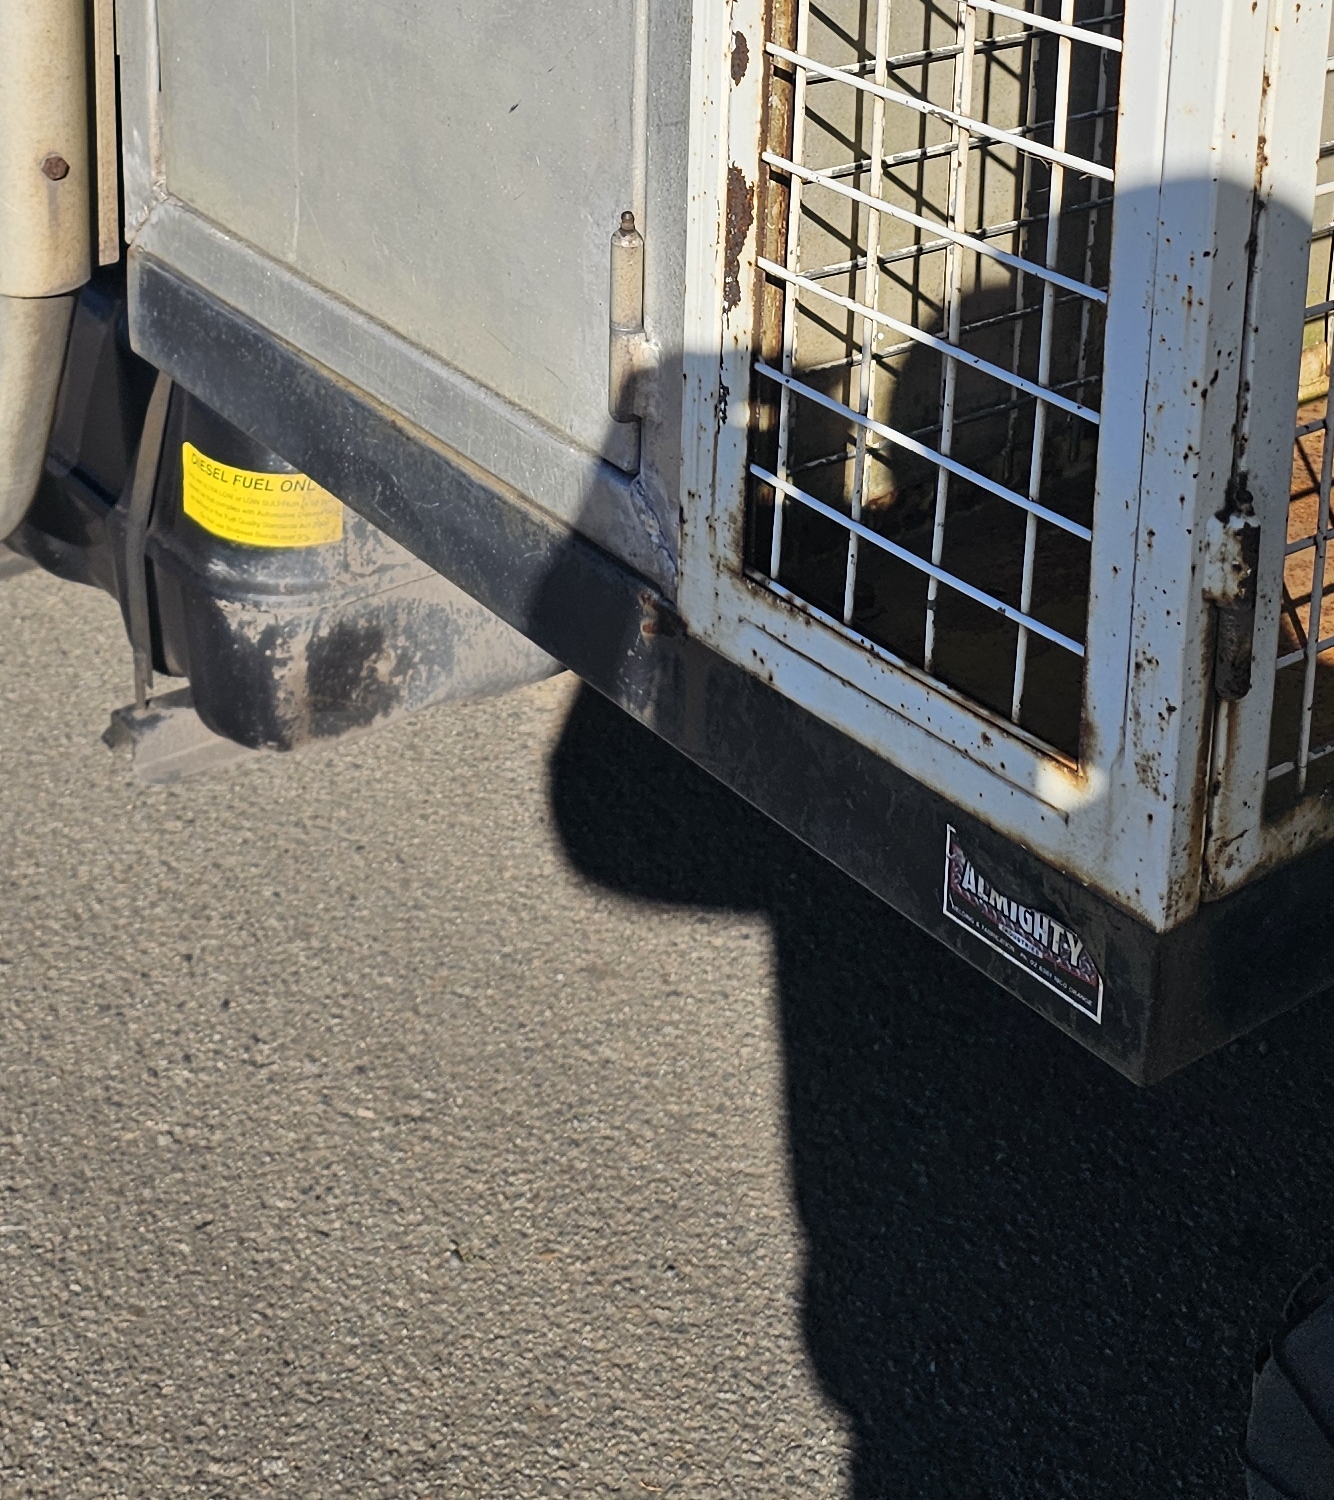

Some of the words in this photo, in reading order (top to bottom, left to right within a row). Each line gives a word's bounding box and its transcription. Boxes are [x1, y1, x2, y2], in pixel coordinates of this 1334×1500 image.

[191, 453, 228, 484] DIESEL
[233, 474, 274, 492] FUEL
[281, 478, 320, 492] ONL
[243, 497, 260, 505] LOW
[238, 517, 260, 528] Quality
[961, 860, 1084, 967] ALMIGHTY
